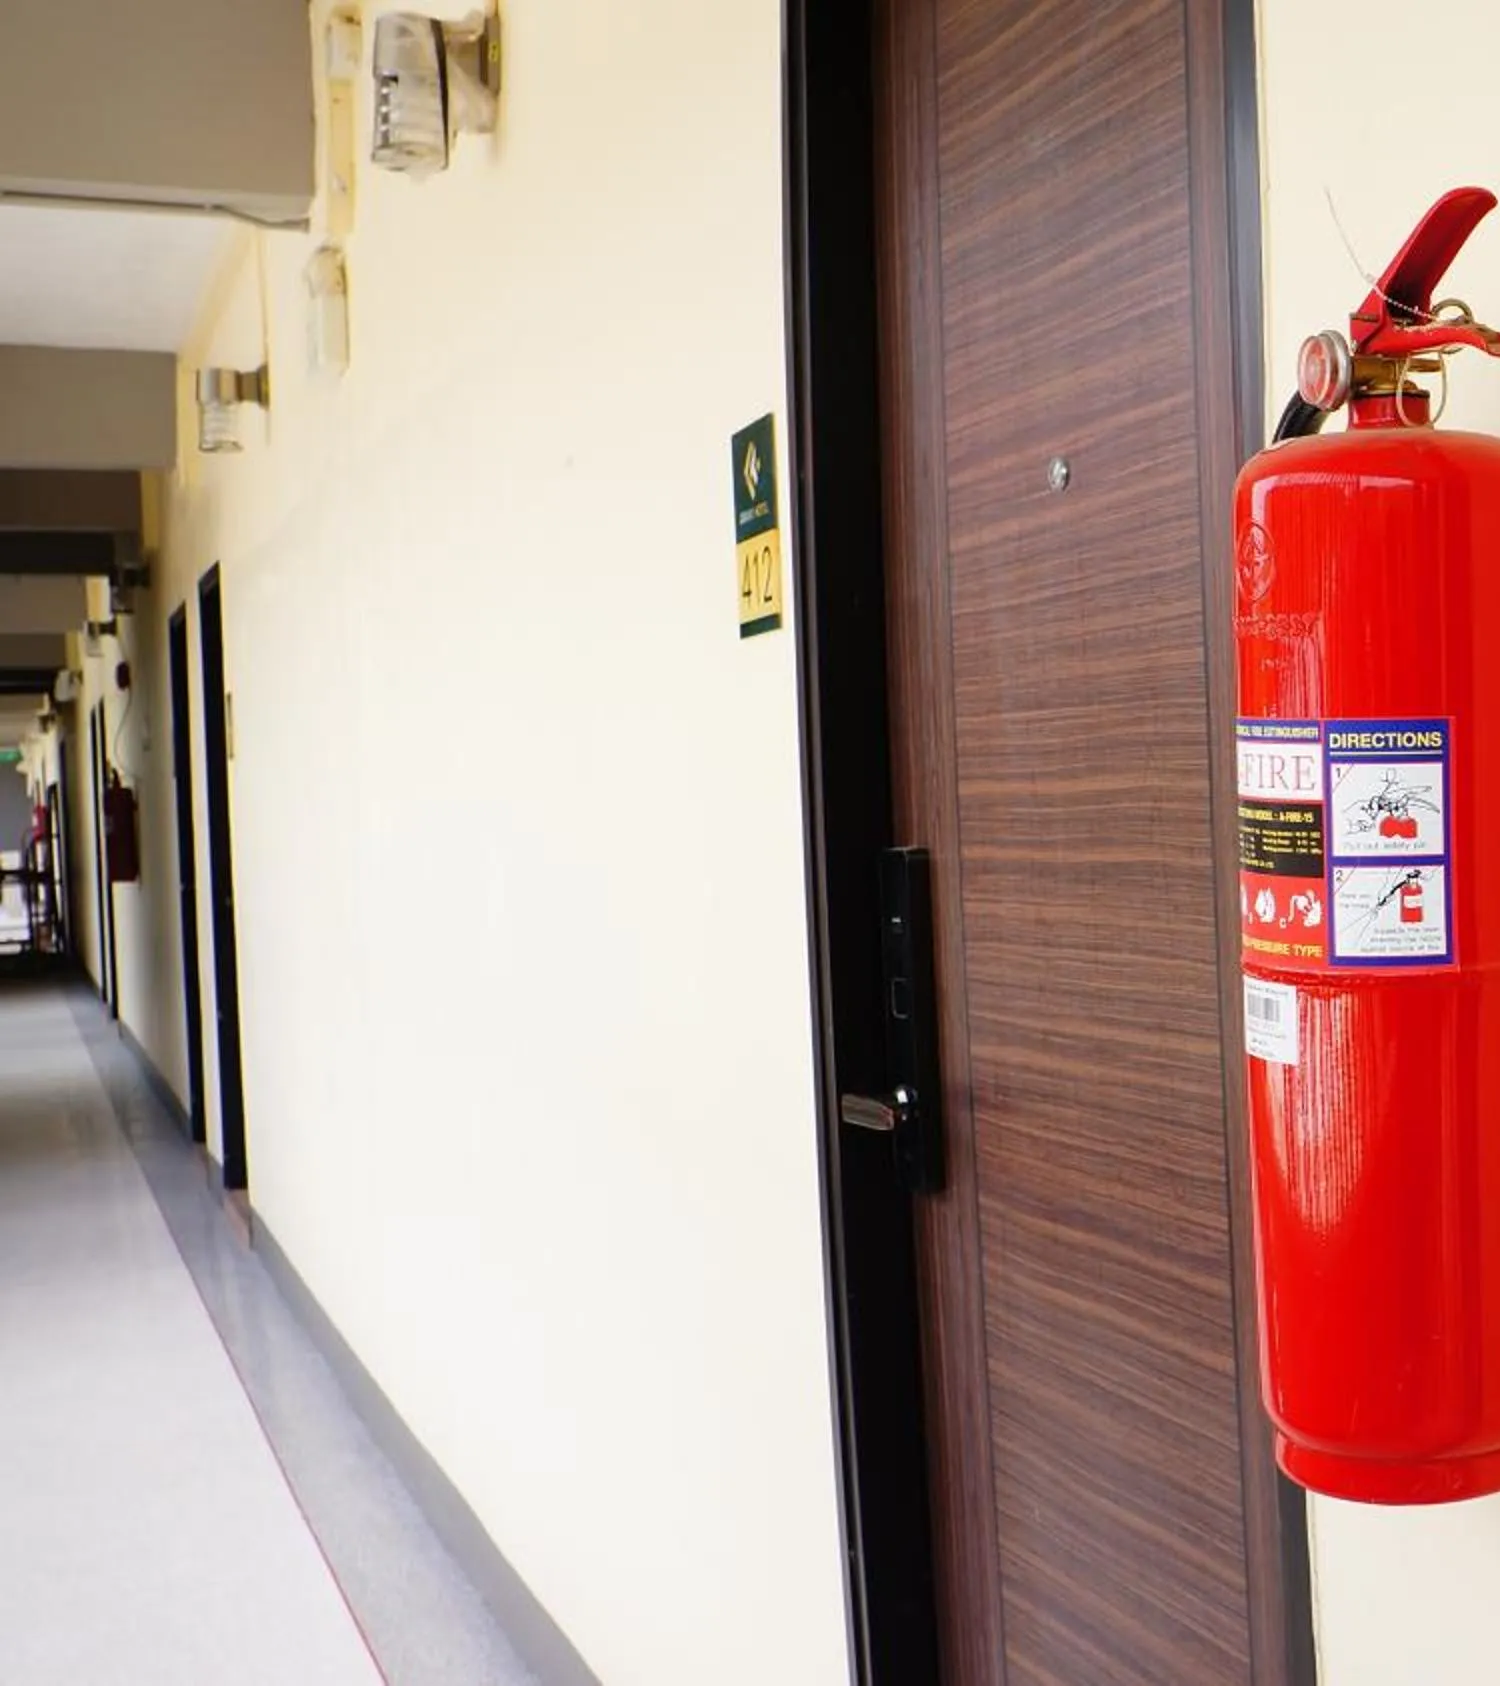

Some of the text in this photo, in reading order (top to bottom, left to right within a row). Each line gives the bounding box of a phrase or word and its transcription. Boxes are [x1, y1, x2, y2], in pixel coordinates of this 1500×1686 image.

[742, 546, 773, 605] 412
[1329, 731, 1443, 749] DIRECTIONS
[1335, 870, 1343, 882] 2
[1292, 943, 1323, 957] TYPE
